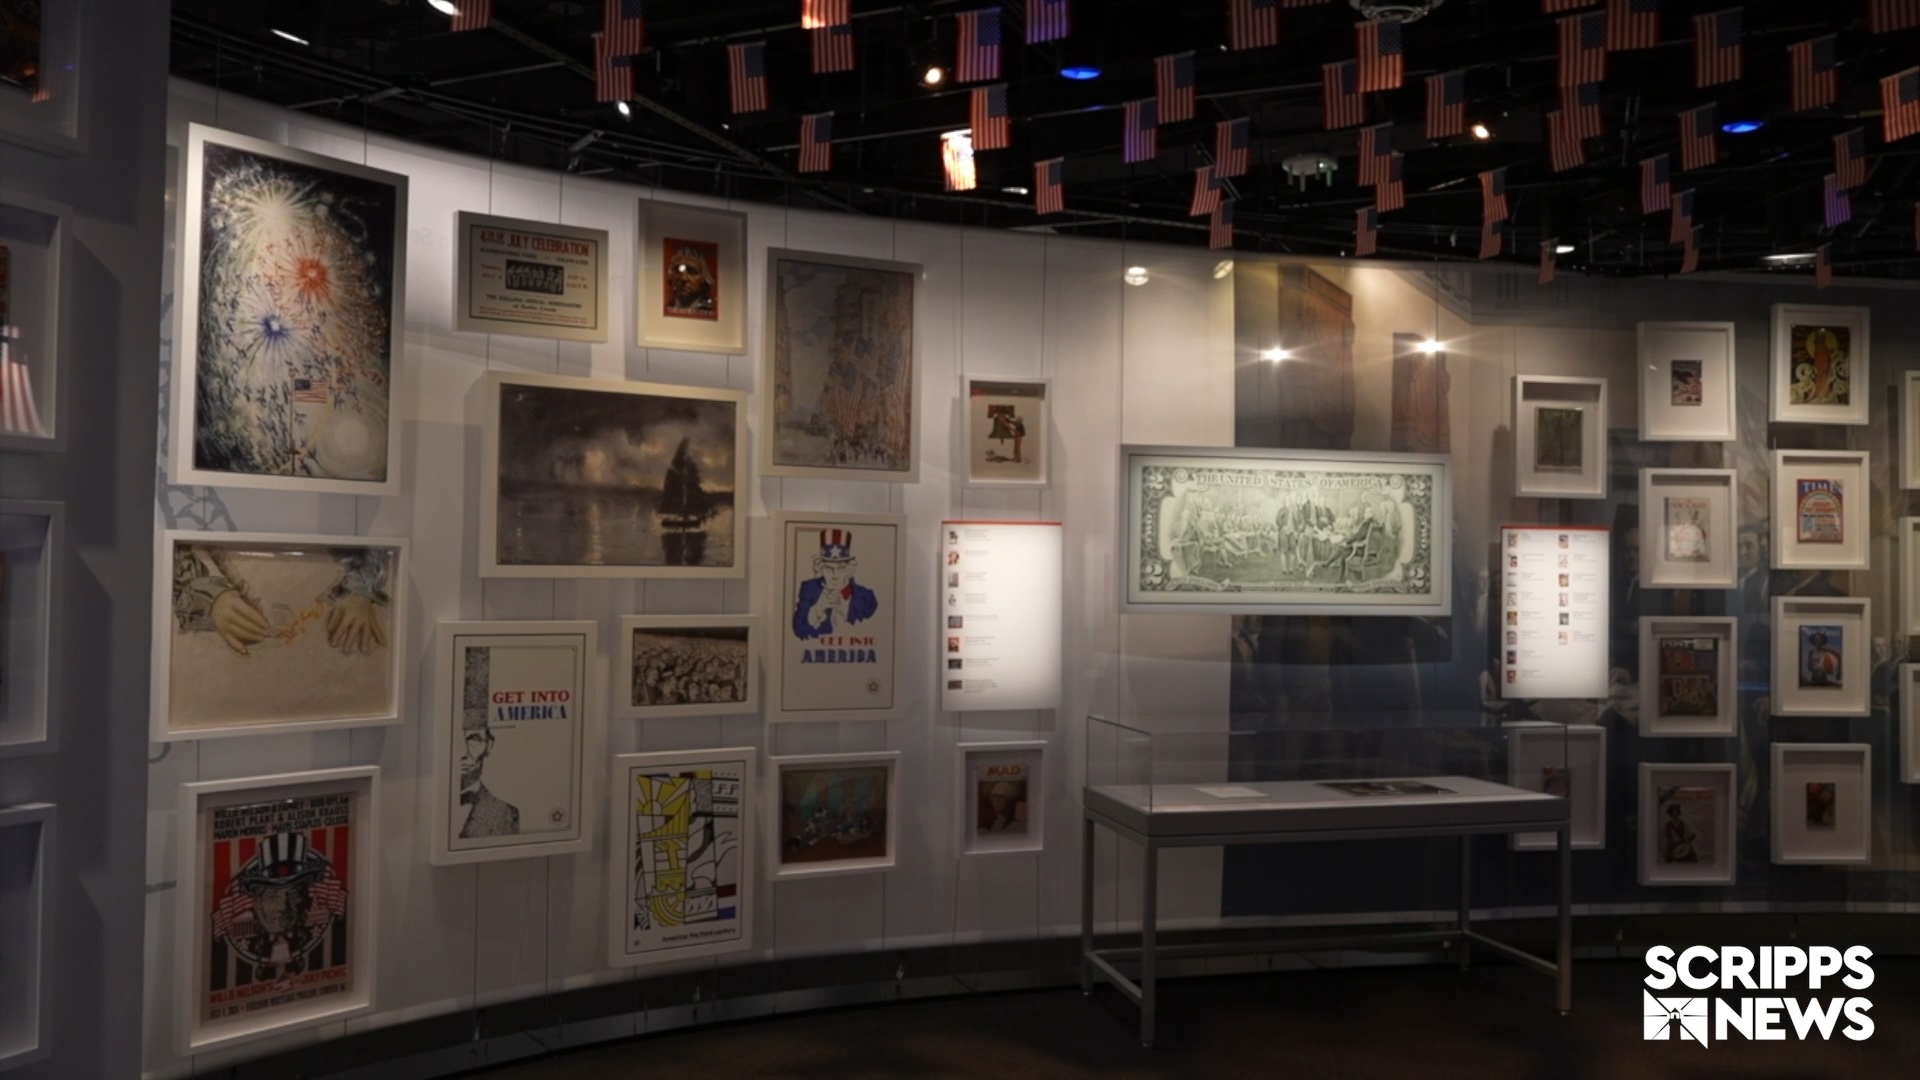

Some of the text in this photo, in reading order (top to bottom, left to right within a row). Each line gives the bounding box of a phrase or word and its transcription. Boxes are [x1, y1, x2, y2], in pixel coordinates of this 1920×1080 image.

[507, 234, 529, 249] JULY
[532, 238, 588, 256] CELEBRATION
[1197, 474, 1384, 489] THE UNITED STATES OF AMERICA
[820, 636, 876, 646] GET INTO
[800, 649, 877, 663] AMERICA
[493, 690, 570, 704] GET INTO
[494, 705, 567, 721] AMERICA
[214, 817, 246, 829] ROBERT
[249, 814, 274, 826] PLANT
[319, 806, 349, 816] KRAUSS
[240, 806, 270, 816] NELSON
[214, 830, 238, 840] MAREN
[240, 826, 267, 837] MORRIS
